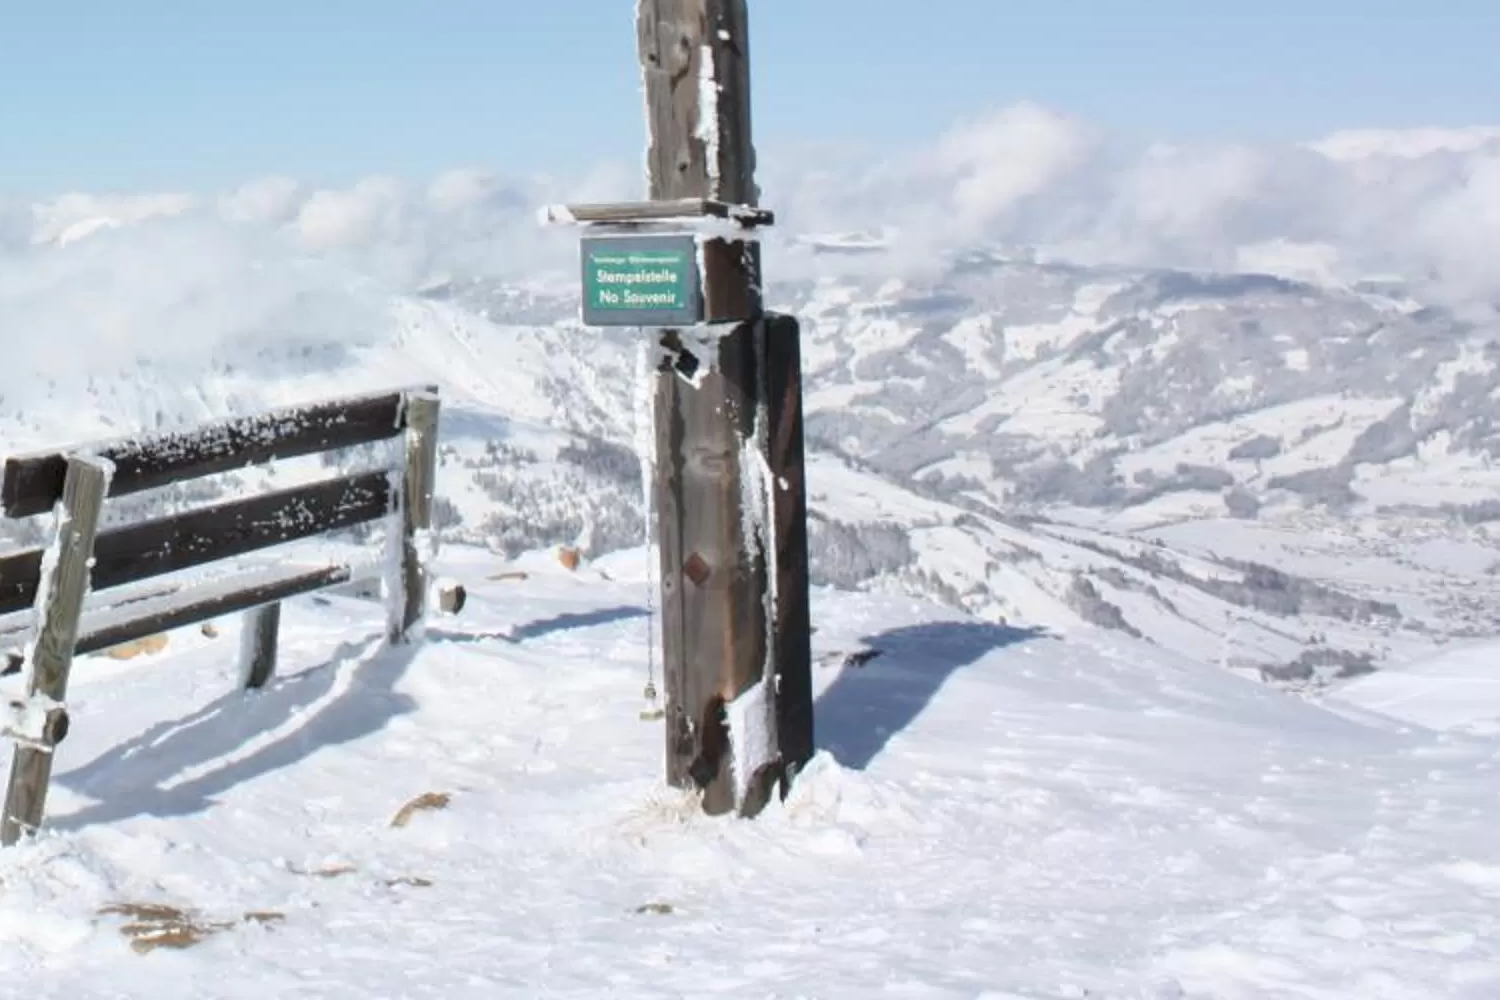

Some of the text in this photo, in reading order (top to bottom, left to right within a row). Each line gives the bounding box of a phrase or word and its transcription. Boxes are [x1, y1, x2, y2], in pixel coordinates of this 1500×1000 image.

[596, 268, 677, 285] Stempelstelle
[600, 289, 676, 304] No Souvenir
